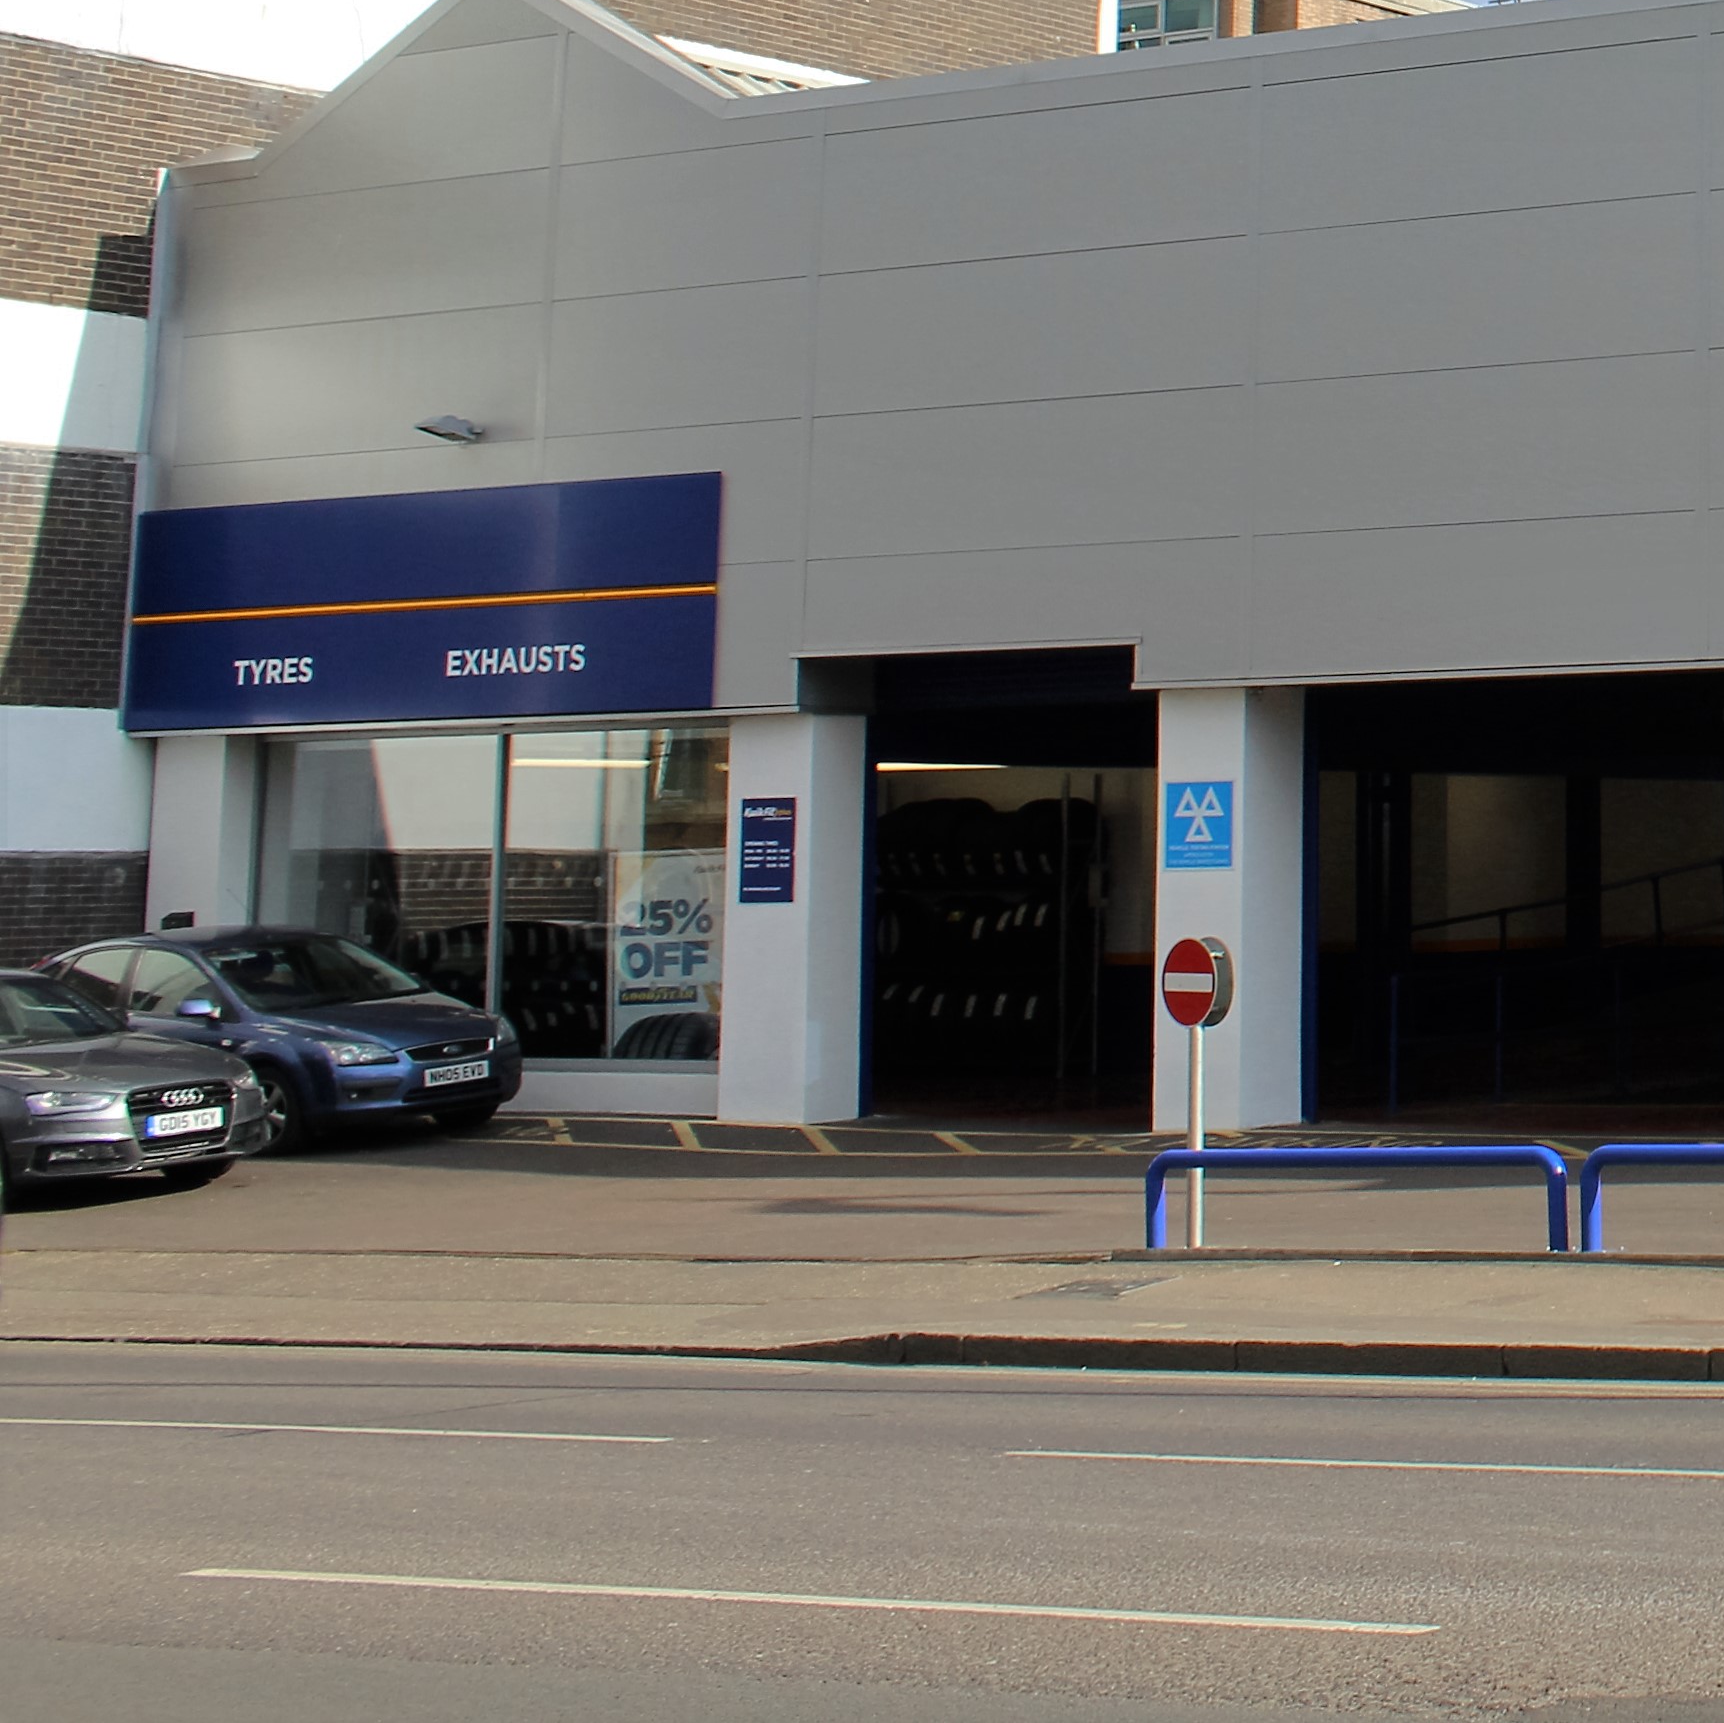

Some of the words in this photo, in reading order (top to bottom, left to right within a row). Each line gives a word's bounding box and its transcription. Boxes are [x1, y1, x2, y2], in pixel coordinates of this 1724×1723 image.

[234, 657, 314, 686] TYRES
[446, 644, 586, 677] EXHAUSTS
[620, 898, 713, 937] 25%
[620, 940, 710, 980] OFF
